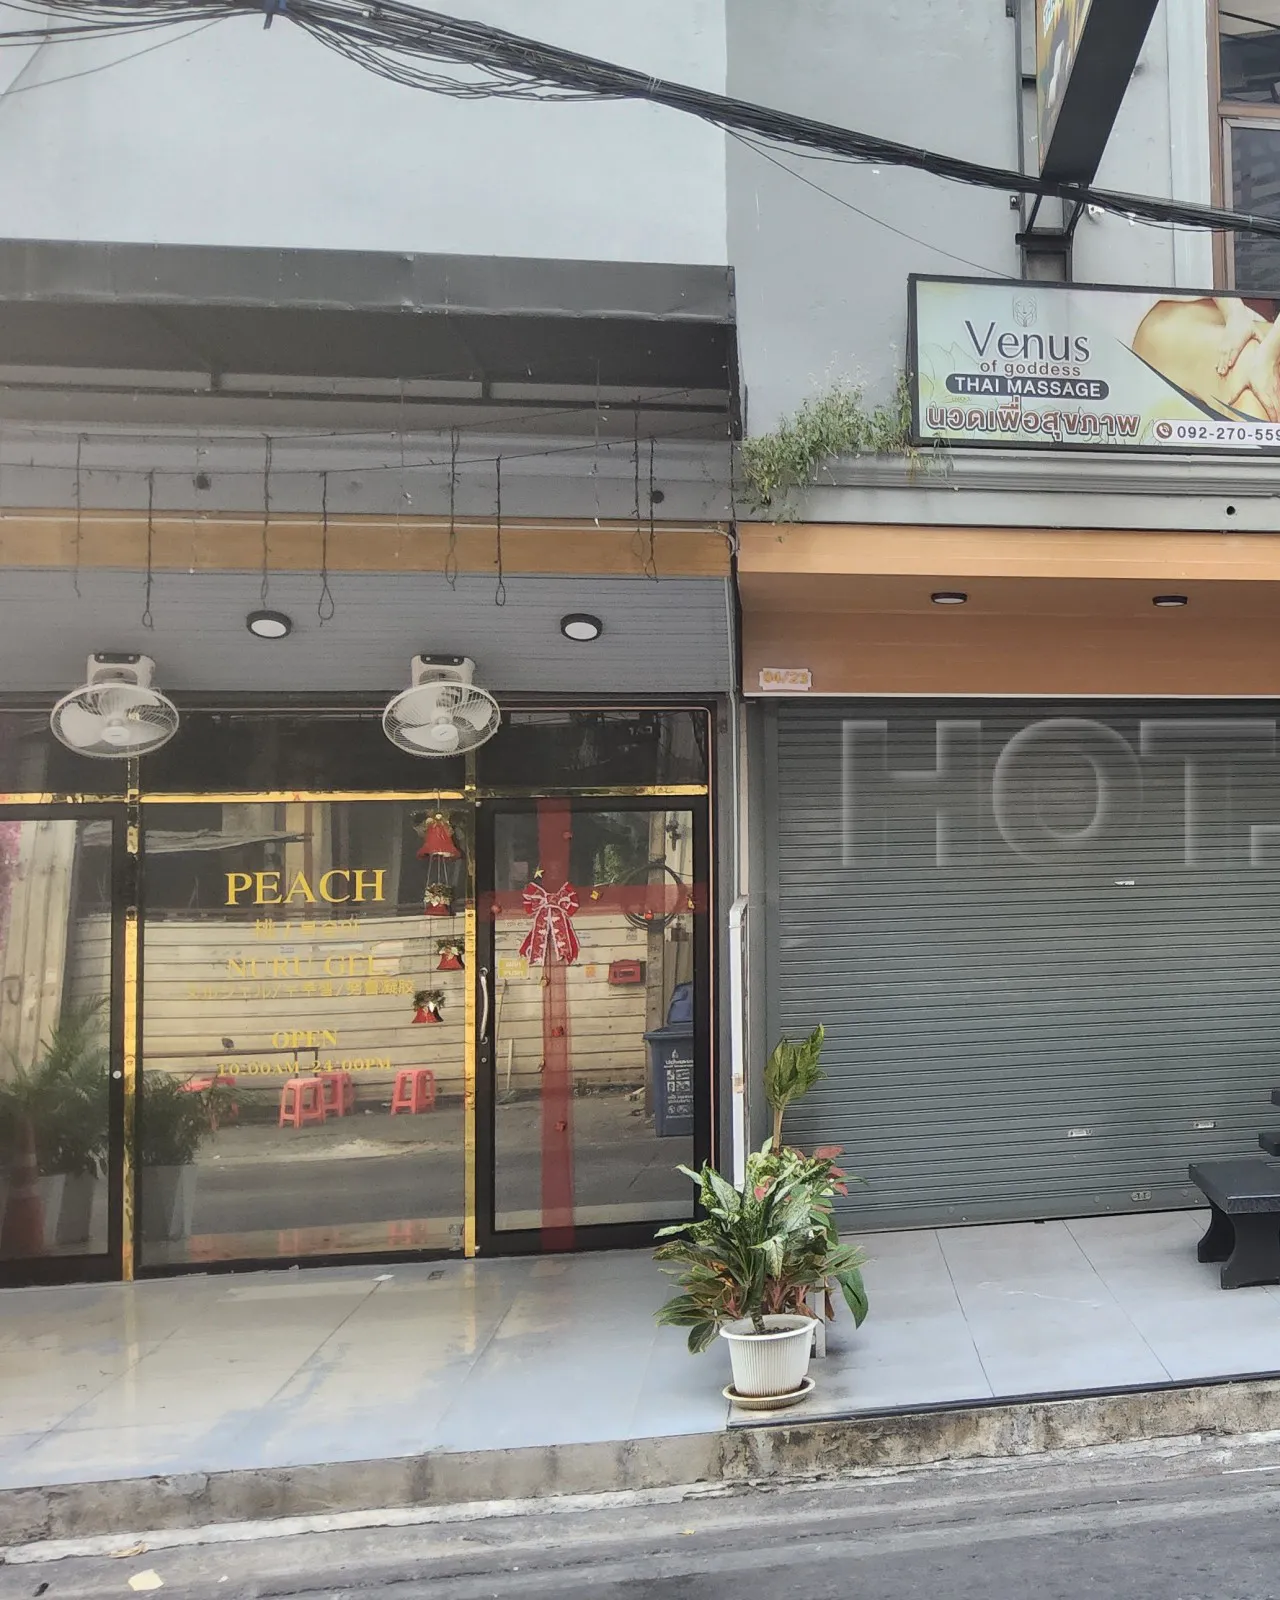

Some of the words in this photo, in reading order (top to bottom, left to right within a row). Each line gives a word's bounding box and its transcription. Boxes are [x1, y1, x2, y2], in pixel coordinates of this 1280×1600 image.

[965, 320, 1090, 362] Venus
[980, 360, 997, 373] of
[1004, 362, 1081, 377] goddess
[955, 376, 1000, 393] THAI
[1007, 379, 1101, 398] MASSAGE
[926, 395, 1140, 441] นวดเพื่อสุขภาพ
[224, 869, 387, 905] PEACH
[227, 955, 312, 978] NURU
[325, 954, 385, 976] GEL
[271, 1029, 338, 1049] OPEN
